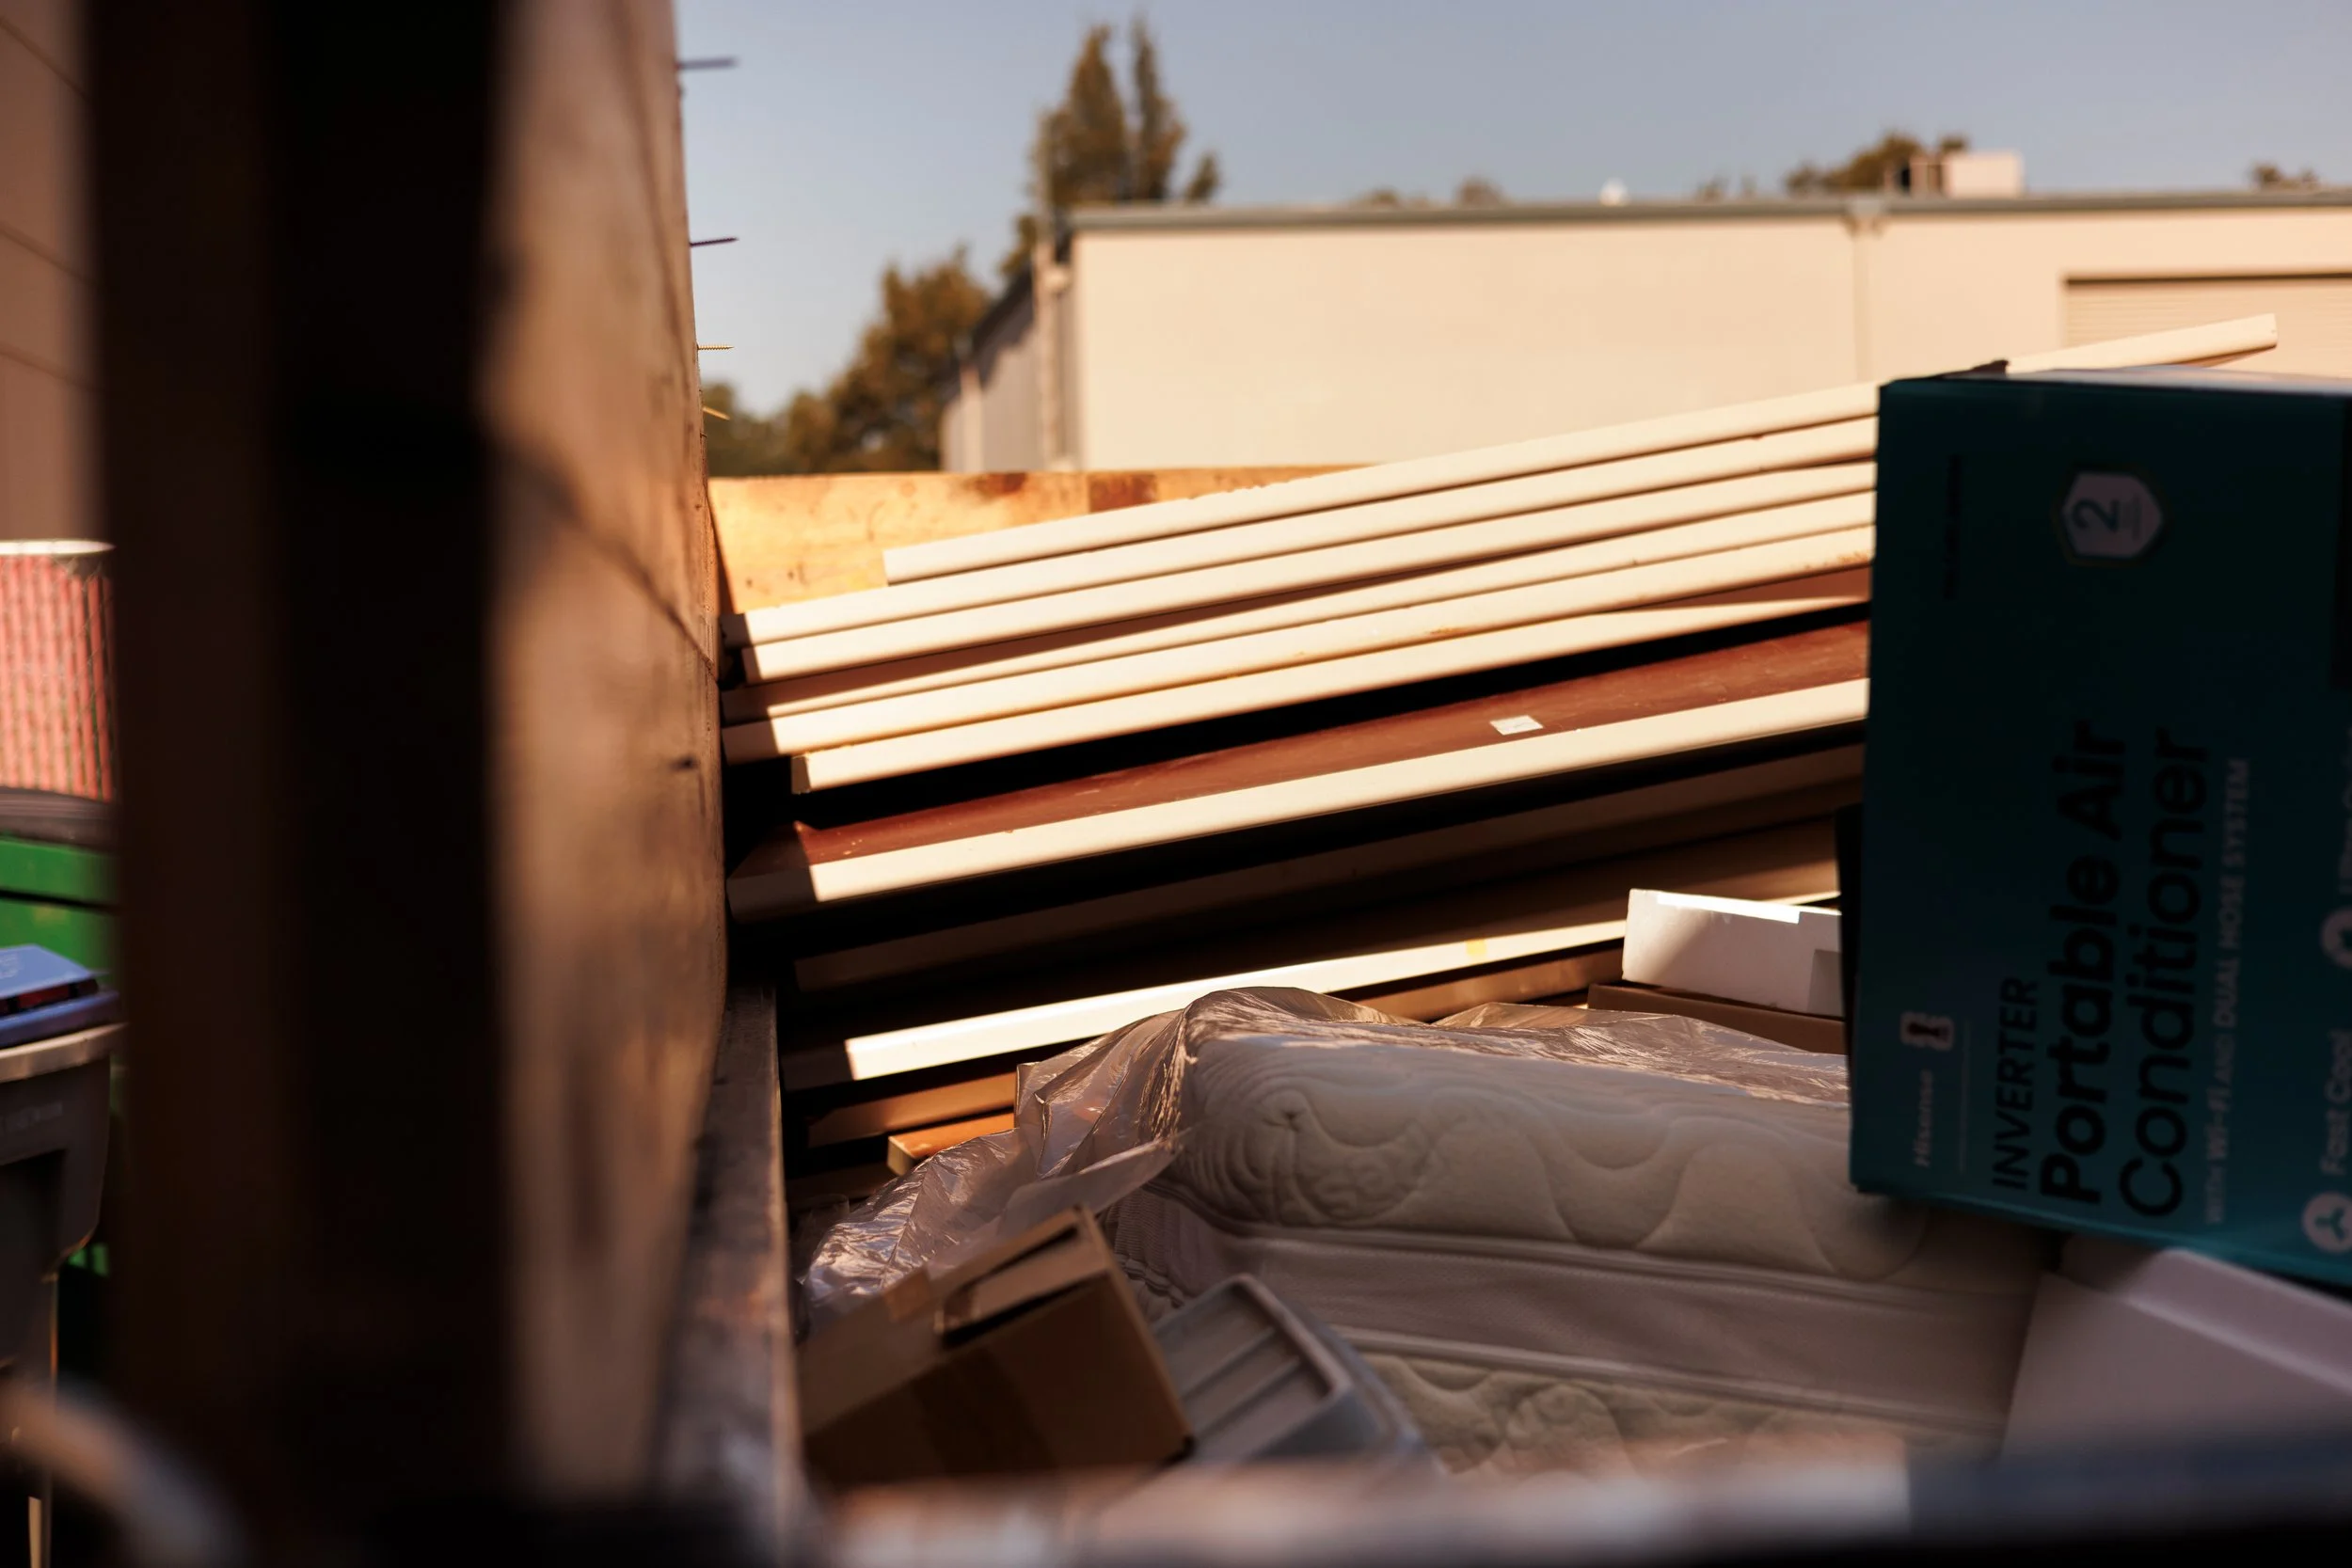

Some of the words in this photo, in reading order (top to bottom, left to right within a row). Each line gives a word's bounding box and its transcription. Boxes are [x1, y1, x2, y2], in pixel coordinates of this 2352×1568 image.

[2071, 498, 2120, 533] 2
[2051, 718, 2126, 843] Air
[2224, 756, 2251, 870] SYSTEM
[2217, 873, 2247, 951] HOSE
[2120, 725, 2210, 1217] Conditioner
[2213, 957, 2240, 1029] DUAL
[2040, 853, 2120, 1203] Portable
[2324, 1028, 2352, 1104] Cool
[1913, 1068, 1934, 1169] Hisense
[1992, 975, 2039, 1191] INVERTER
[2206, 1086, 2231, 1160] Wi-Fi
[2320, 1109, 2349, 1176] Fast
